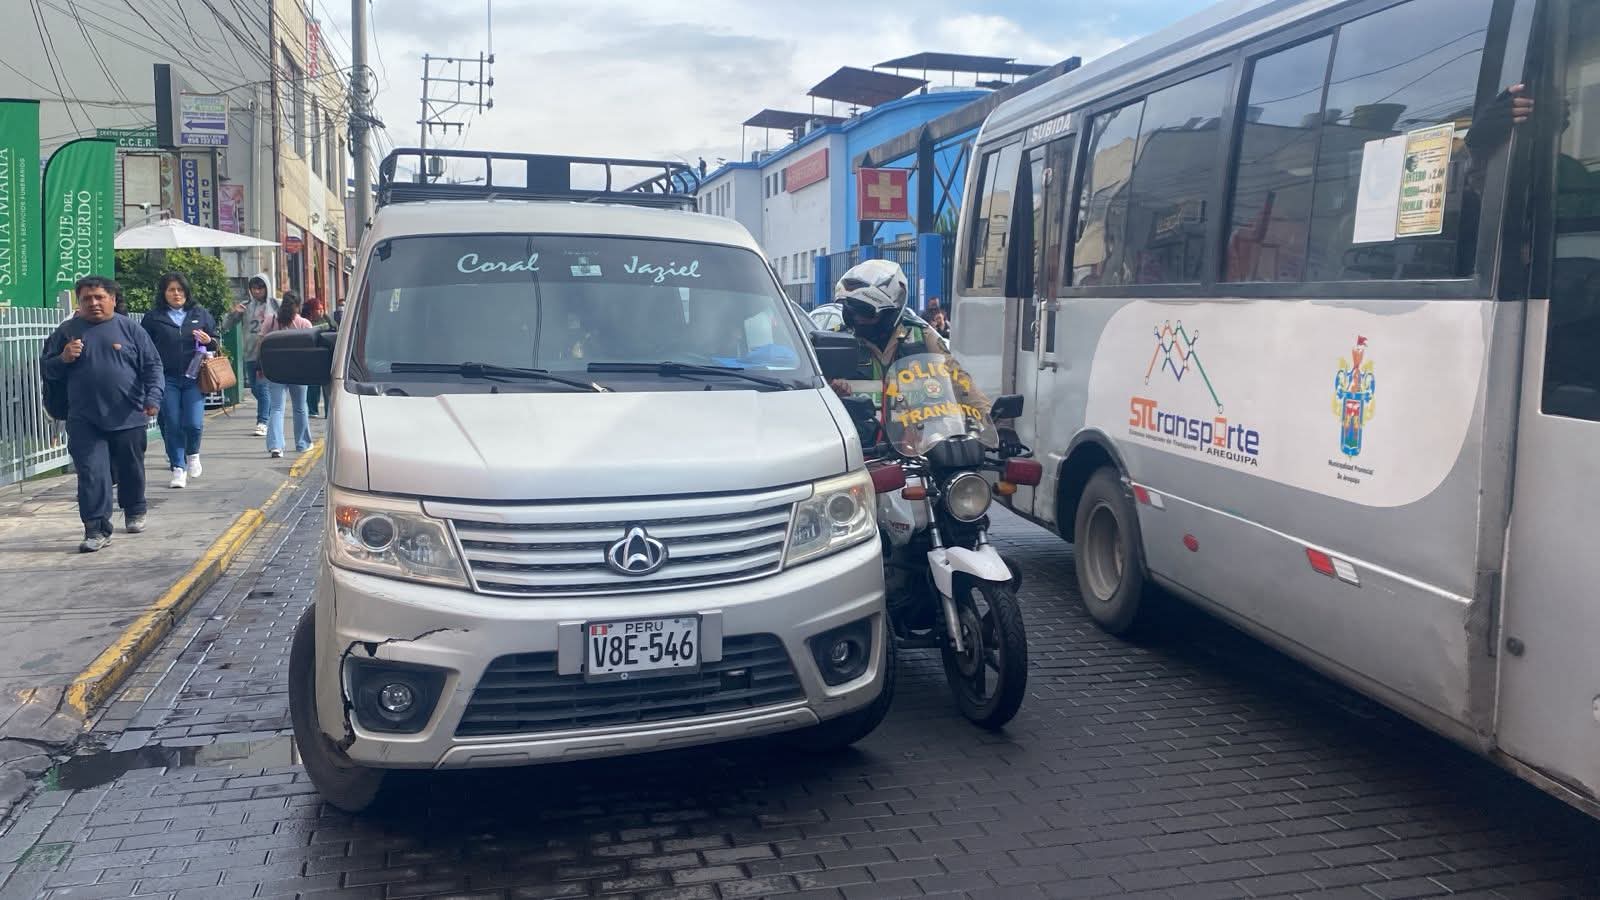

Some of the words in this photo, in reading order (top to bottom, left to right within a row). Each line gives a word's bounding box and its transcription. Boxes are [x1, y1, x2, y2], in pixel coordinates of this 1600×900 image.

[1031, 113, 1072, 142] SUBIDA
[63, 190, 74, 212] DEL
[56, 216, 76, 283] PARQUE
[75, 190, 92, 283] RECUERDO
[457, 253, 540, 273] Coral
[623, 255, 701, 283] Jaziel
[1206, 447, 1258, 467] AREQUIPA
[625, 621, 664, 633] PERU
[593, 630, 694, 668] V8E-546
